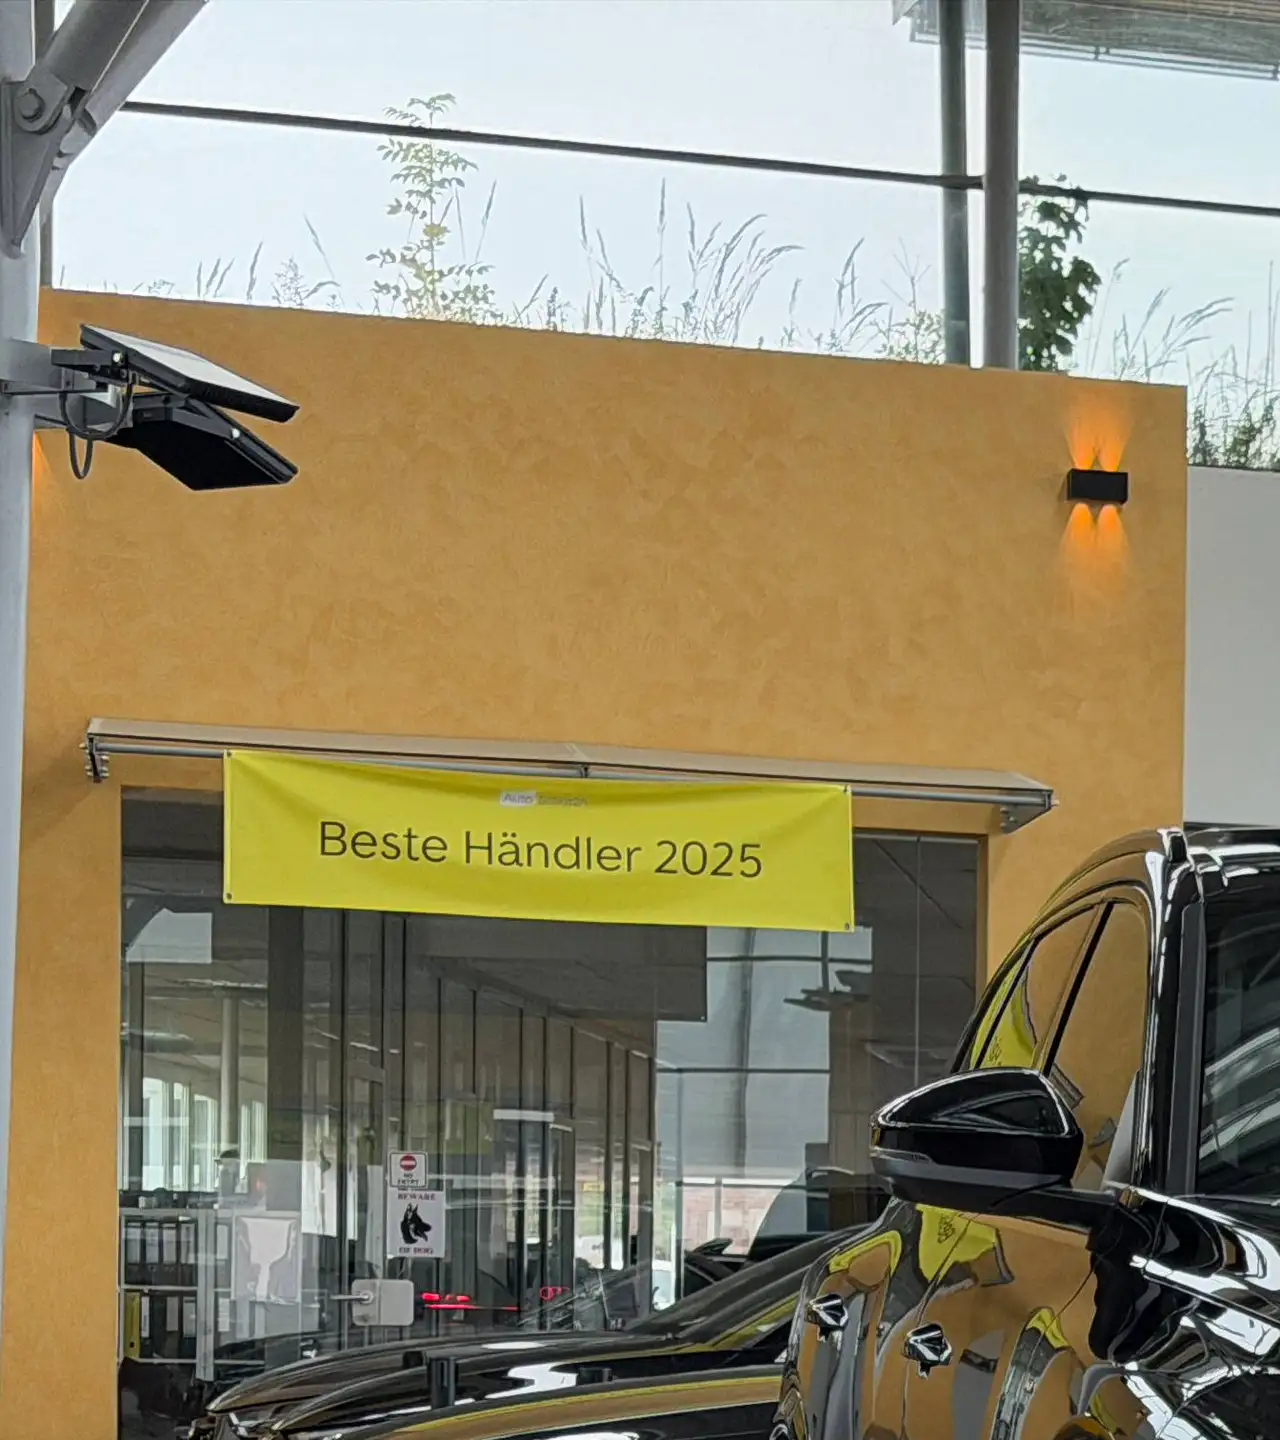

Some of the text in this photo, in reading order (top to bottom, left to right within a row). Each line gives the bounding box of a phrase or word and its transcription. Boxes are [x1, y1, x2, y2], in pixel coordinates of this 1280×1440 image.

[319, 820, 763, 879] Beste Händler 2025
